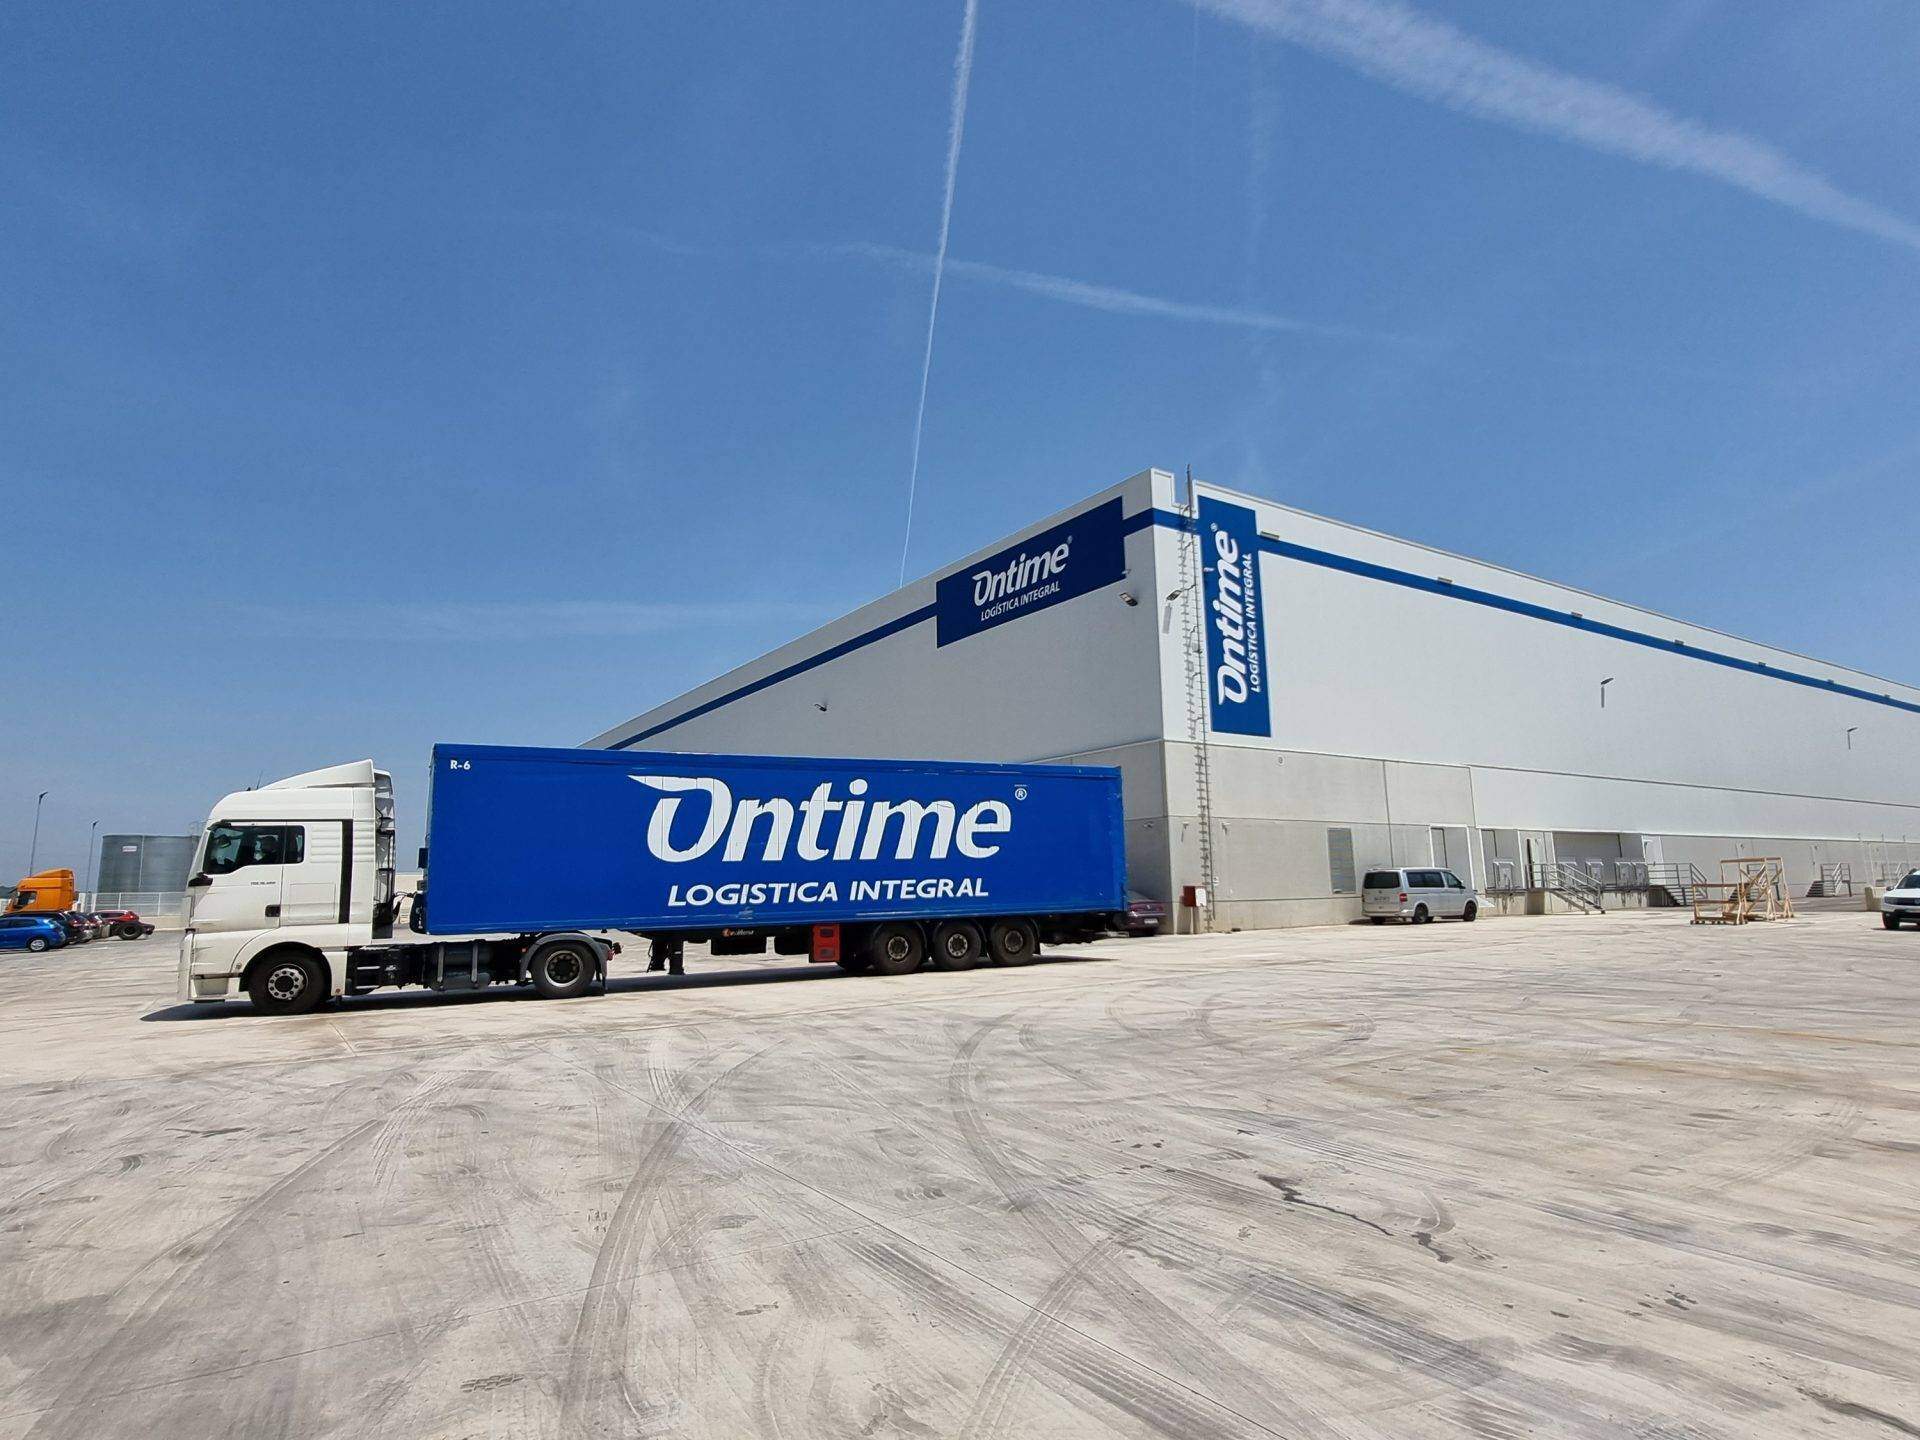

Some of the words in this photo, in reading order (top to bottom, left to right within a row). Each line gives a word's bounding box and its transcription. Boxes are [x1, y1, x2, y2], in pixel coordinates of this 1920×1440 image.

[972, 543, 1070, 607] Ontime
[1020, 580, 1061, 606] INTEGRAL
[1242, 553, 1257, 618] INTEGRAL
[1213, 530, 1247, 705] Ontime
[449, 759, 471, 771] R-6
[627, 774, 1012, 863] Ontime
[849, 877, 989, 901] INTEGRAL
